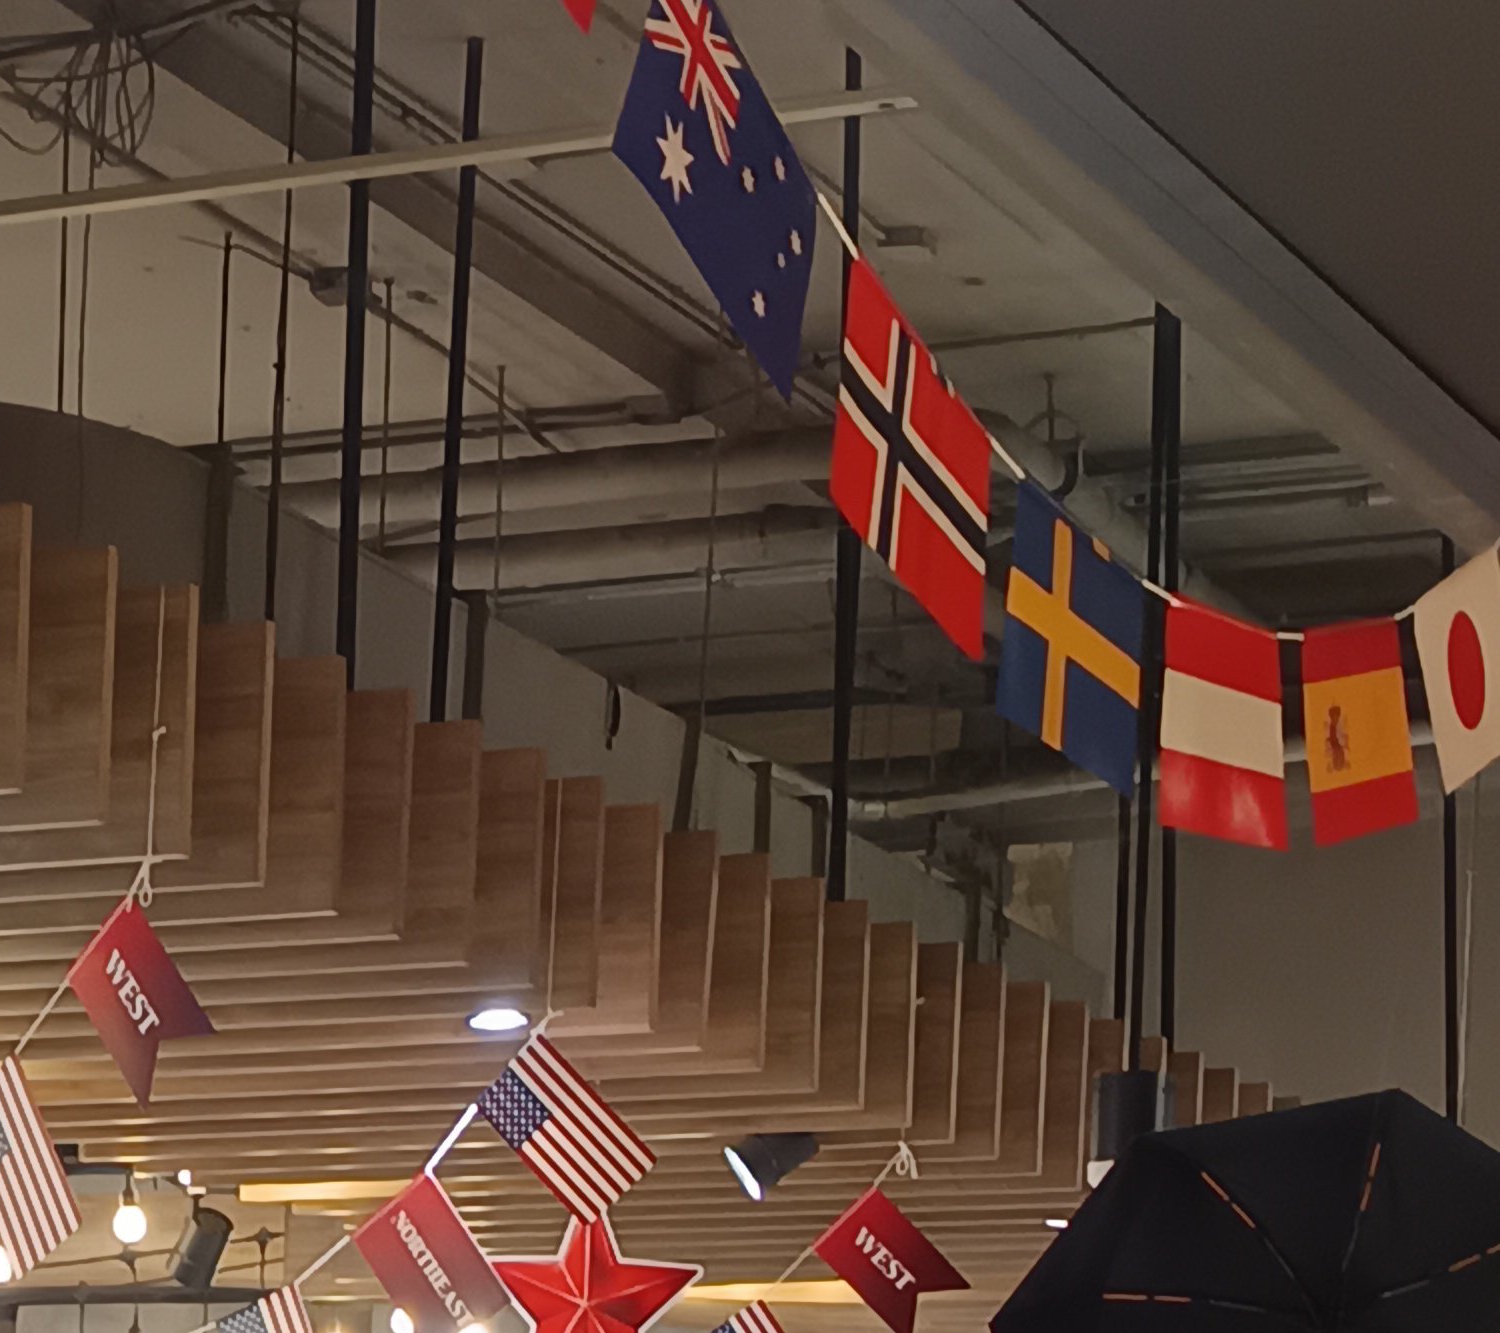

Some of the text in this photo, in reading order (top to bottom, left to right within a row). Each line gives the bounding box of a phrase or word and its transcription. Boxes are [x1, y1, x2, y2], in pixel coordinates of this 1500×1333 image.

[105, 949, 159, 1037] WEST
[389, 1208, 476, 1327] NORTHEAST
[855, 1226, 916, 1291] WEST
